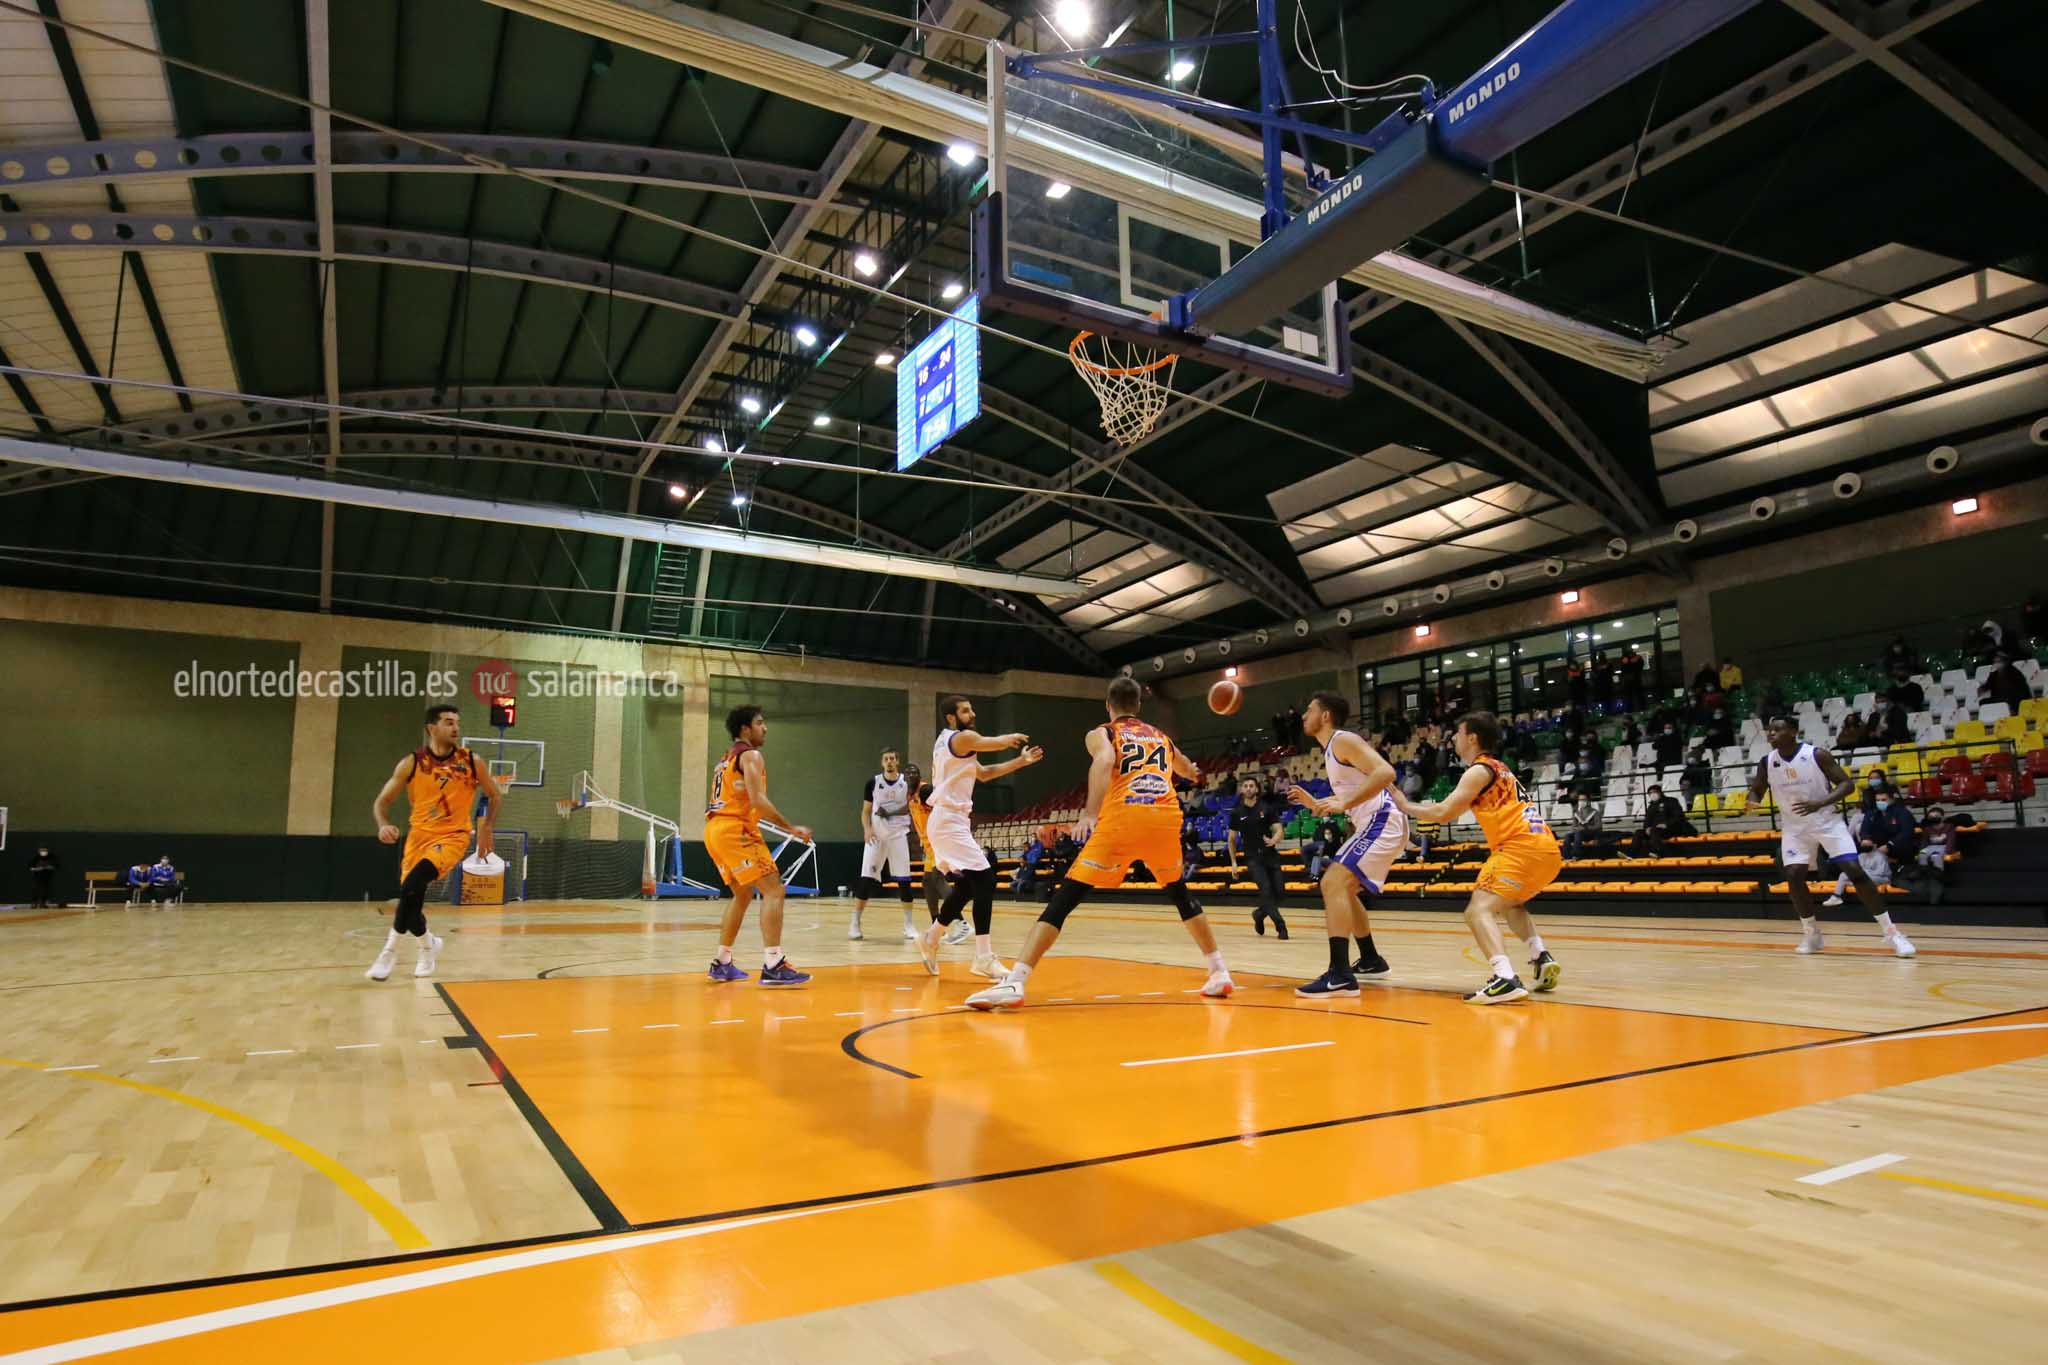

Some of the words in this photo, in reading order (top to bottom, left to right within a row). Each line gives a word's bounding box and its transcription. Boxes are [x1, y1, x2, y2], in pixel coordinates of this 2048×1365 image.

[1448, 61, 1521, 124] MONDO
[1306, 174, 1363, 225] MONDO
[1119, 743, 1169, 776] 24
[1352, 838, 1374, 857] CBM
